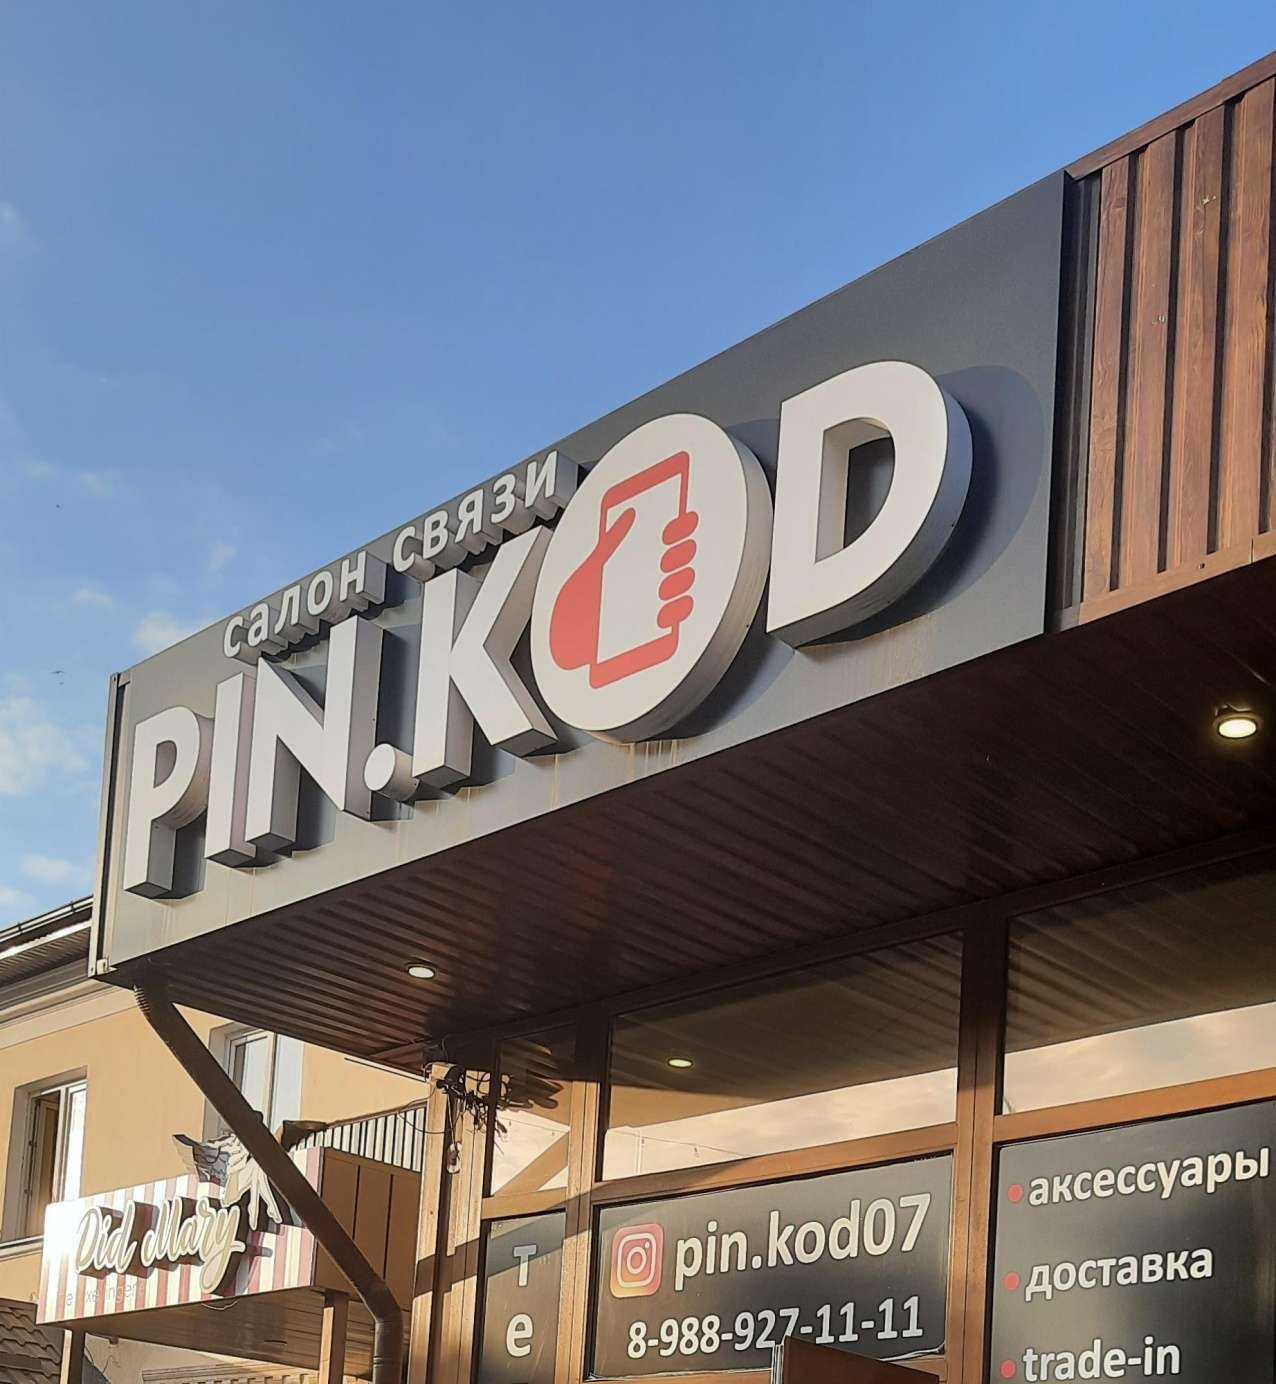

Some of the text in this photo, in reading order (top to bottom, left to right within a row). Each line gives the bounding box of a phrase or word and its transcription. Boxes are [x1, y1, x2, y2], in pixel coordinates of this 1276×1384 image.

[223, 449, 560, 660] салон связи
[1027, 1146, 1271, 1207] аксессуары
[141, 1196, 246, 1294] Mary
[673, 1192, 933, 1292] pin.kod07
[1024, 1246, 1214, 1303] доставка
[626, 1295, 925, 1359] 8-988-927-11-11
[1021, 1335, 1182, 1383] trade-in
